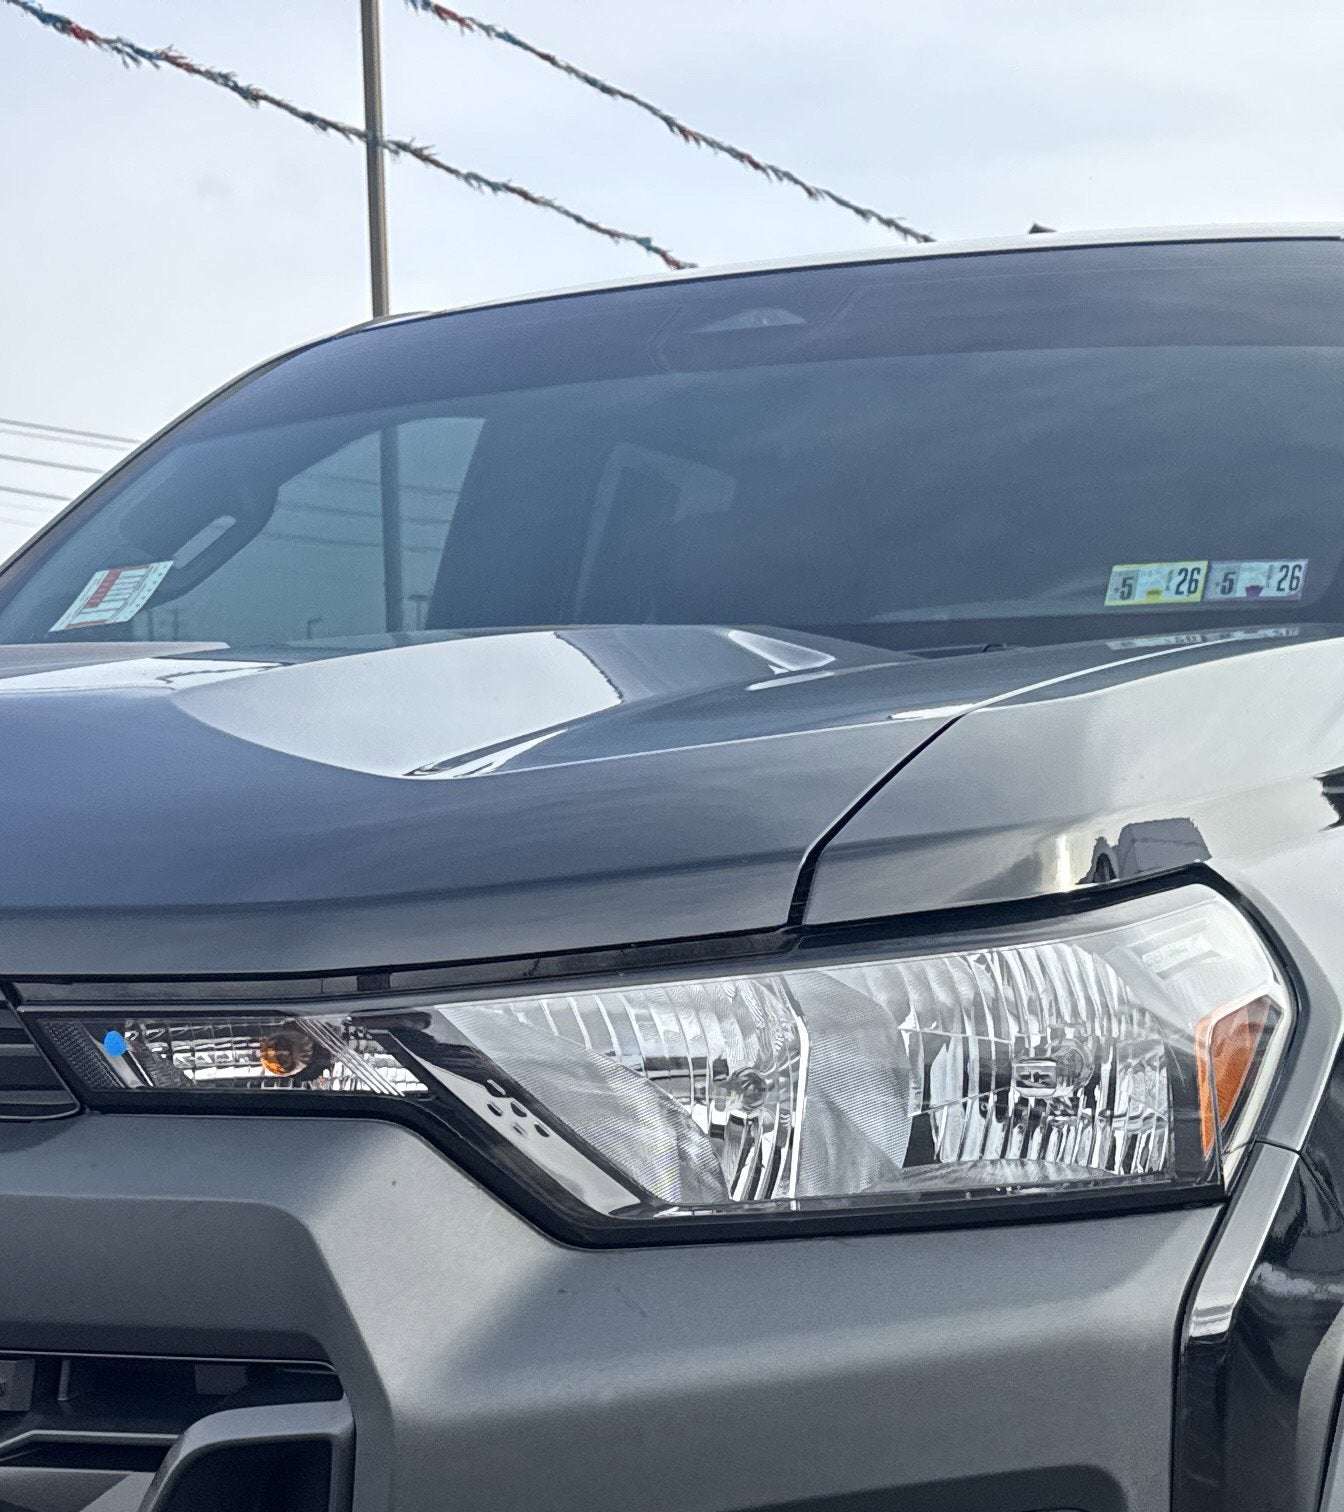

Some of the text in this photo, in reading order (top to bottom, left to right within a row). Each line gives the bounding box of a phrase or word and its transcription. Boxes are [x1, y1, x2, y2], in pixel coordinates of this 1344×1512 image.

[1119, 576, 1134, 600] 5
[1175, 567, 1201, 596] 26
[1220, 571, 1236, 595] 5
[1276, 564, 1302, 593] 26
